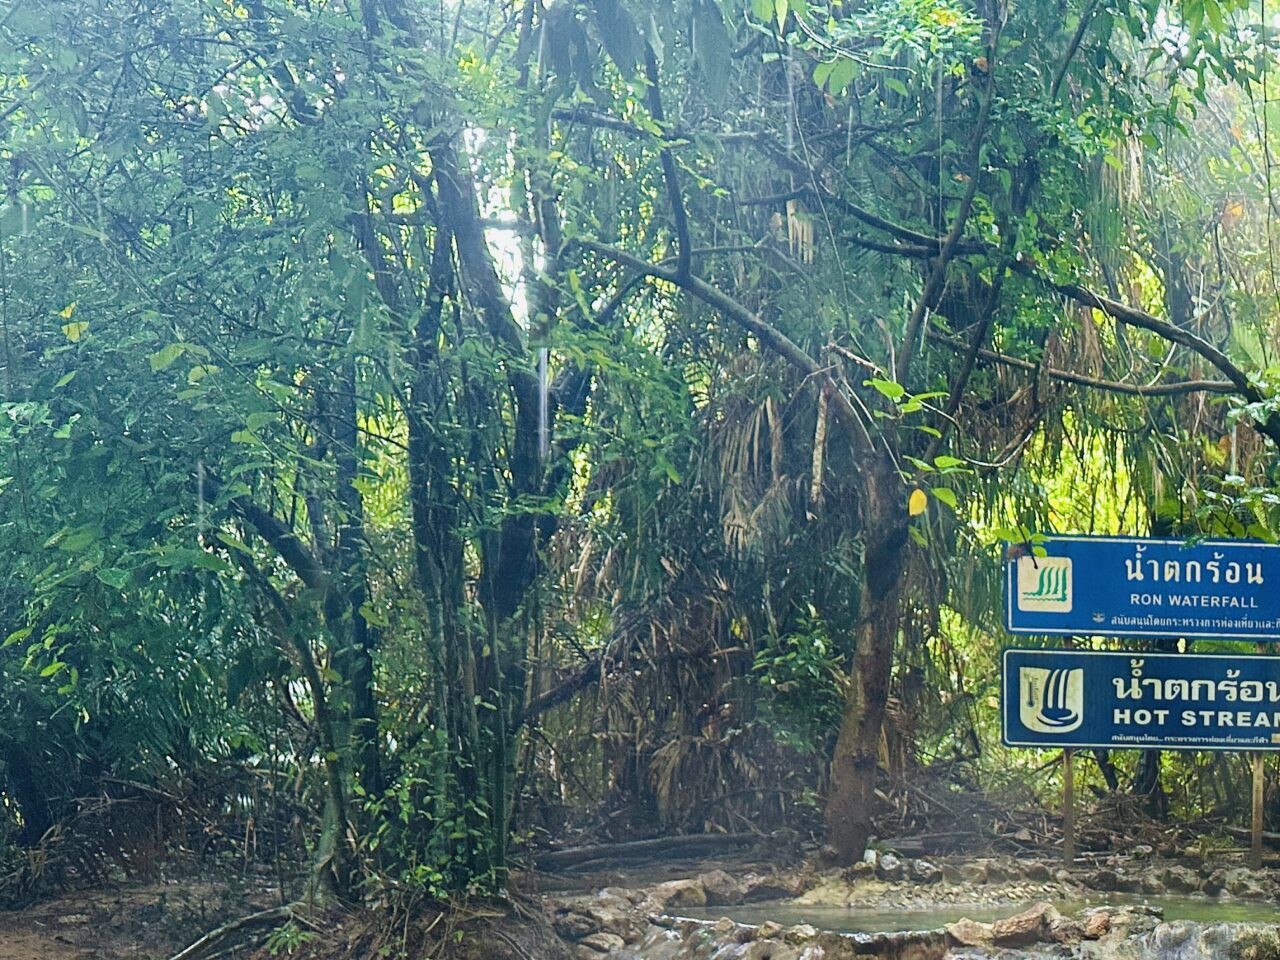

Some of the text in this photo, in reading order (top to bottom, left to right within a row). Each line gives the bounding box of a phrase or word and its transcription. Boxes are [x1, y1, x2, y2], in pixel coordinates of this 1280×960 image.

[1125, 545, 1265, 585] น้ำตกร้อน
[1130, 593, 1259, 608] RON WATERFALL
[1113, 708, 1170, 725] HOT
